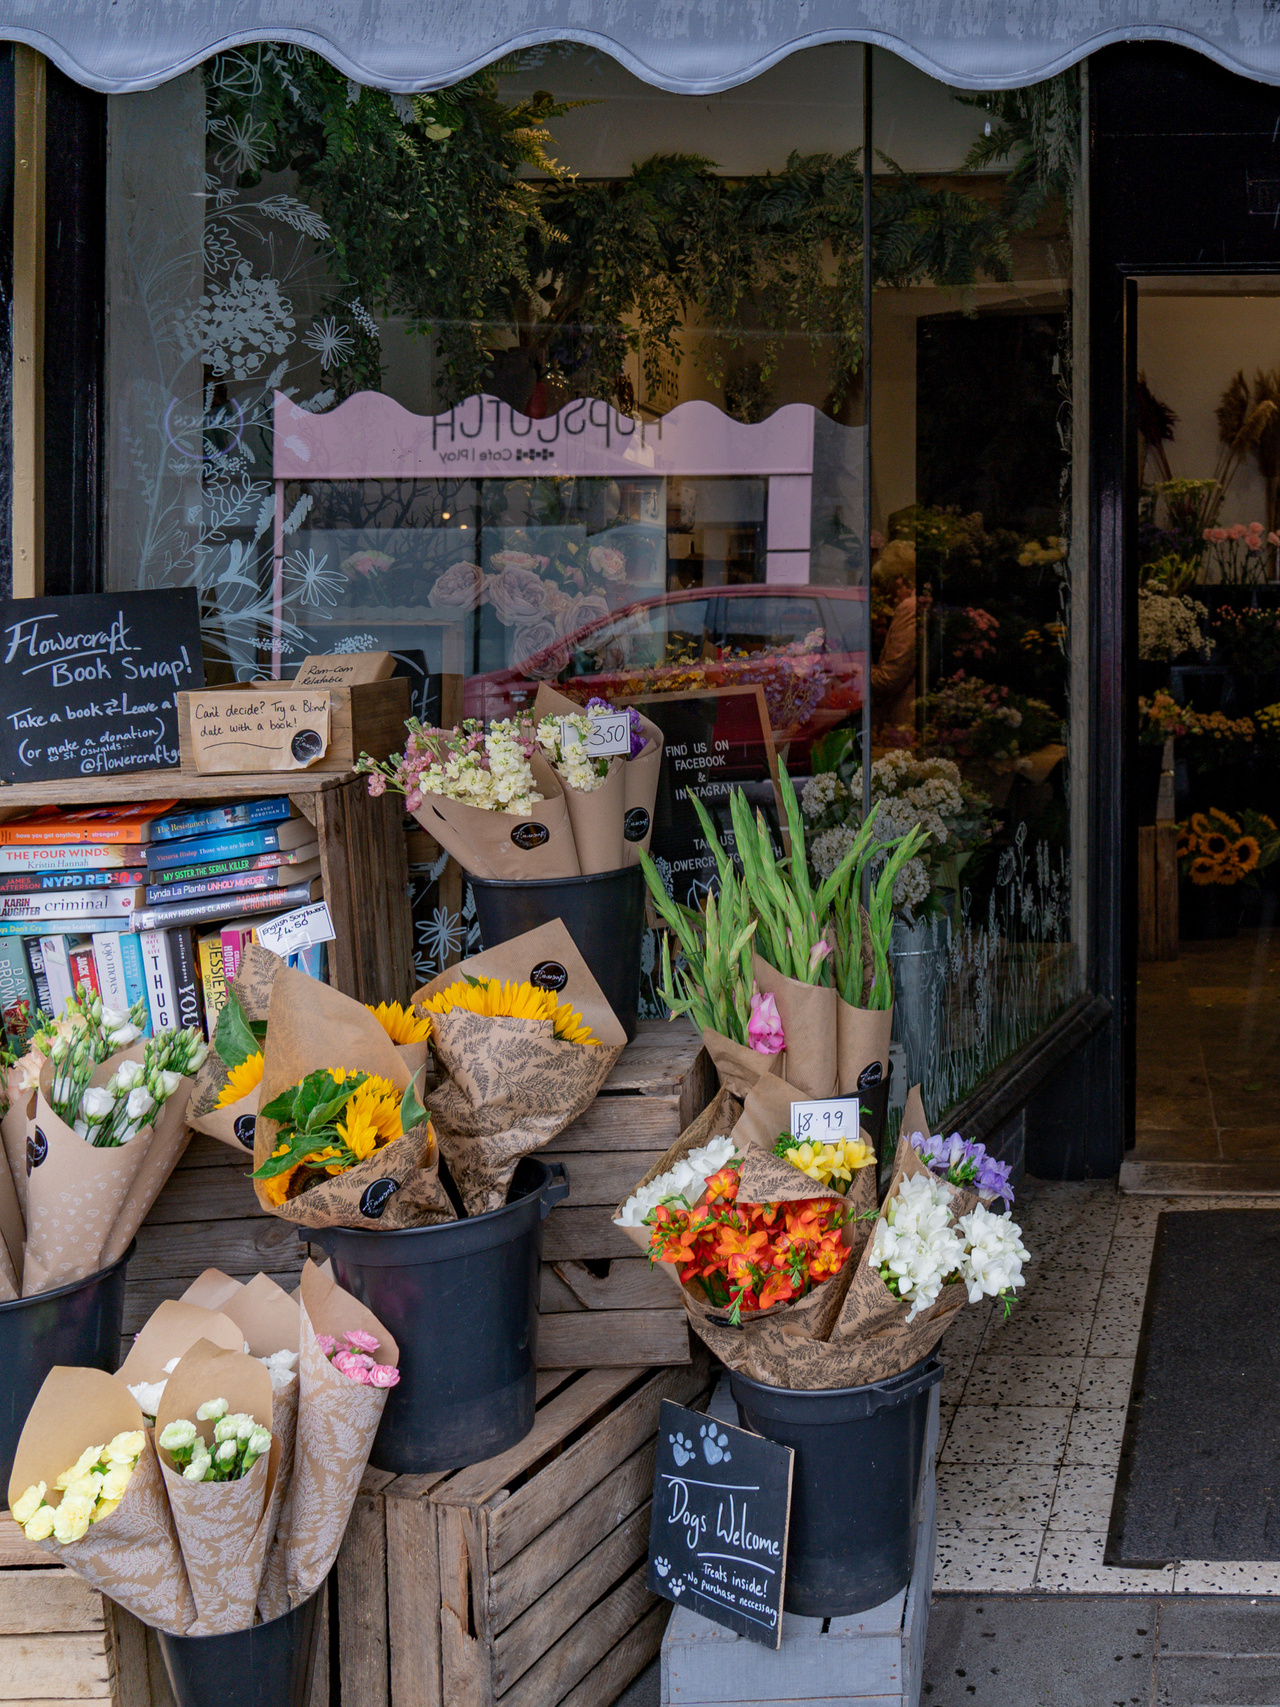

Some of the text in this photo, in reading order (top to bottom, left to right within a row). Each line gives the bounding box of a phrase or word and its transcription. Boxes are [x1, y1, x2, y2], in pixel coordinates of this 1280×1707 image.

[4, 611, 133, 663] Flowercraft
[52, 645, 193, 687] Book Swap!
[7, 707, 48, 731] Take
[50, 711, 62, 723] a
[66, 699, 104, 719] book
[121, 692, 160, 715] Leave
[161, 699, 173, 712] a
[226, 701, 266, 718] decide?
[271, 701, 287, 721] Try
[289, 705, 297, 713] a
[303, 700, 327, 713] Blind
[47, 741, 80, 757] make
[85, 738, 96, 746] a
[99, 717, 166, 744] donation)
[200, 718, 298, 737] date with a book!
[48, 754, 60, 763] to
[665, 740, 729, 757] FIND US ON
[675, 755, 726, 771] FACEBOOK
[698, 772, 706, 783] &
[44, 832, 54, 840] got
[55, 832, 81, 840] anything
[91, 831, 119, 840] stronger?
[156, 825, 169, 834] The
[171, 818, 205, 832] Resistance
[156, 852, 179, 861] Victoria
[199, 846, 215, 855] Those
[239, 840, 254, 848] loved
[720, 835, 735, 846] US
[6, 847, 110, 861] THE FOUR WINDS
[27, 859, 89, 869] Kristin Hannah
[42, 876, 83, 888] NYPD
[84, 873, 112, 886] RED
[163, 873, 174, 881] MY
[196, 867, 207, 877] THE
[208, 864, 228, 875] SERIAL
[229, 860, 250, 873] KILLER
[149, 876, 265, 900] Lynda La Plante UNHOLY MURDER
[268, 888, 288, 899] GONE
[4, 898, 30, 908] KARIN
[44, 895, 109, 912] criminal
[158, 903, 231, 921] MARY HIGGINS CLARK
[30, 924, 42, 933] Cry
[72, 922, 96, 930] Scarlett
[262, 918, 289, 935] English
[77, 956, 90, 976] JACK
[101, 941, 119, 995] jojo moyes
[130, 944, 138, 978] CHRISTY
[208, 945, 225, 988] JESSIE
[223, 945, 235, 978] HOOVER
[0, 959, 19, 1010] BROWN
[13, 967, 28, 996] DAN
[796, 1110, 844, 1139] £8.99
[668, 1479, 780, 1556] Dogs Welcome
[701, 1580, 736, 1602] purchase
[732, 1570, 768, 1597] inside!
